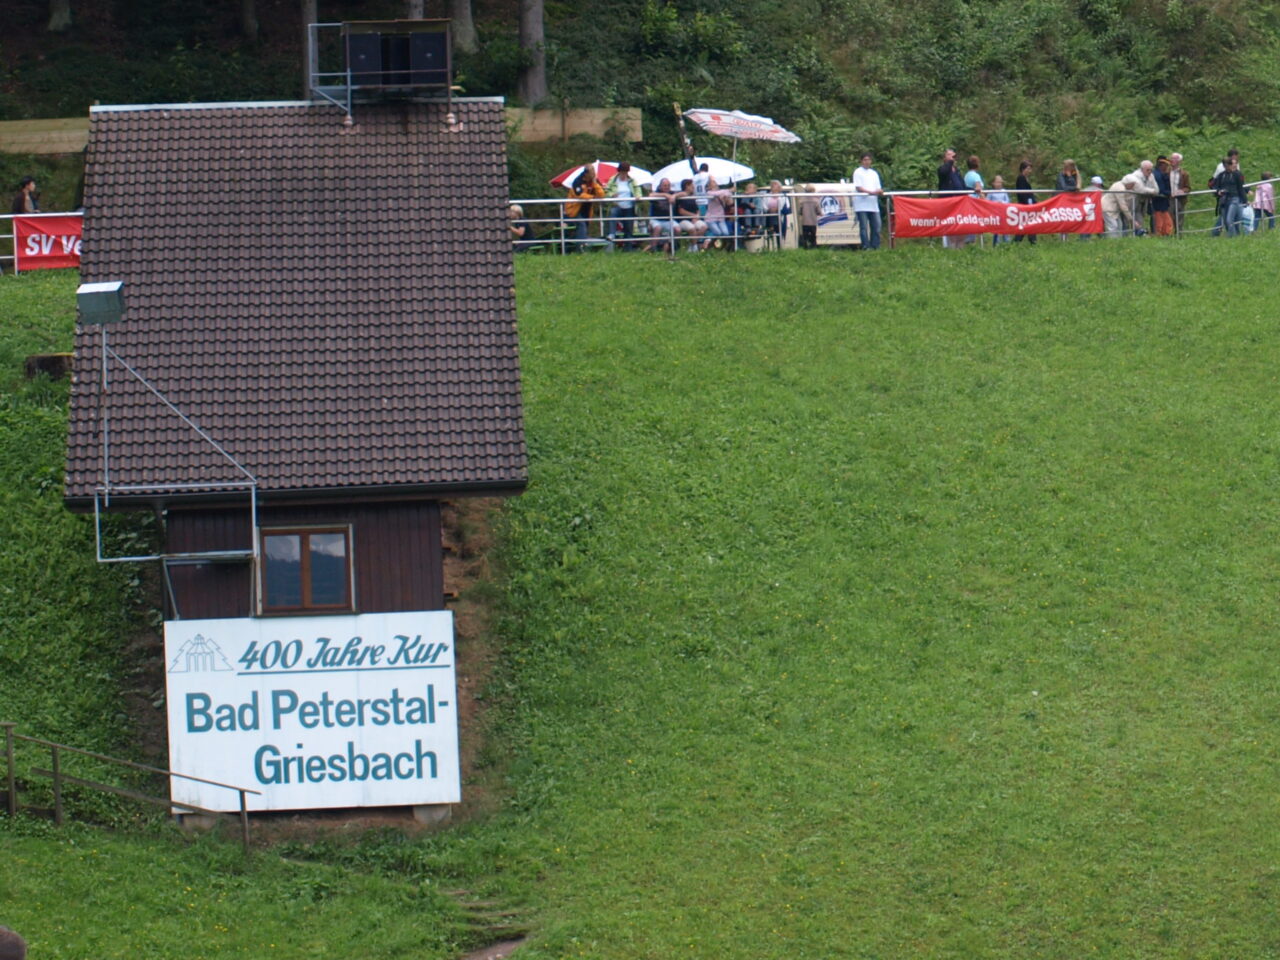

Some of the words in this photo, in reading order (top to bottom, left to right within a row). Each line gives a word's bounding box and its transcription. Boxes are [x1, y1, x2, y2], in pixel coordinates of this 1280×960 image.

[956, 214, 977, 224] Geld
[1006, 206, 1083, 230] Sparkasse
[25, 234, 56, 256] SV
[237, 639, 303, 669] 400
[306, 636, 385, 668] Jahre
[387, 634, 450, 665] Kur
[185, 690, 260, 733] Bad
[271, 684, 449, 730] Peterstal-
[254, 739, 438, 784] Griesbach
